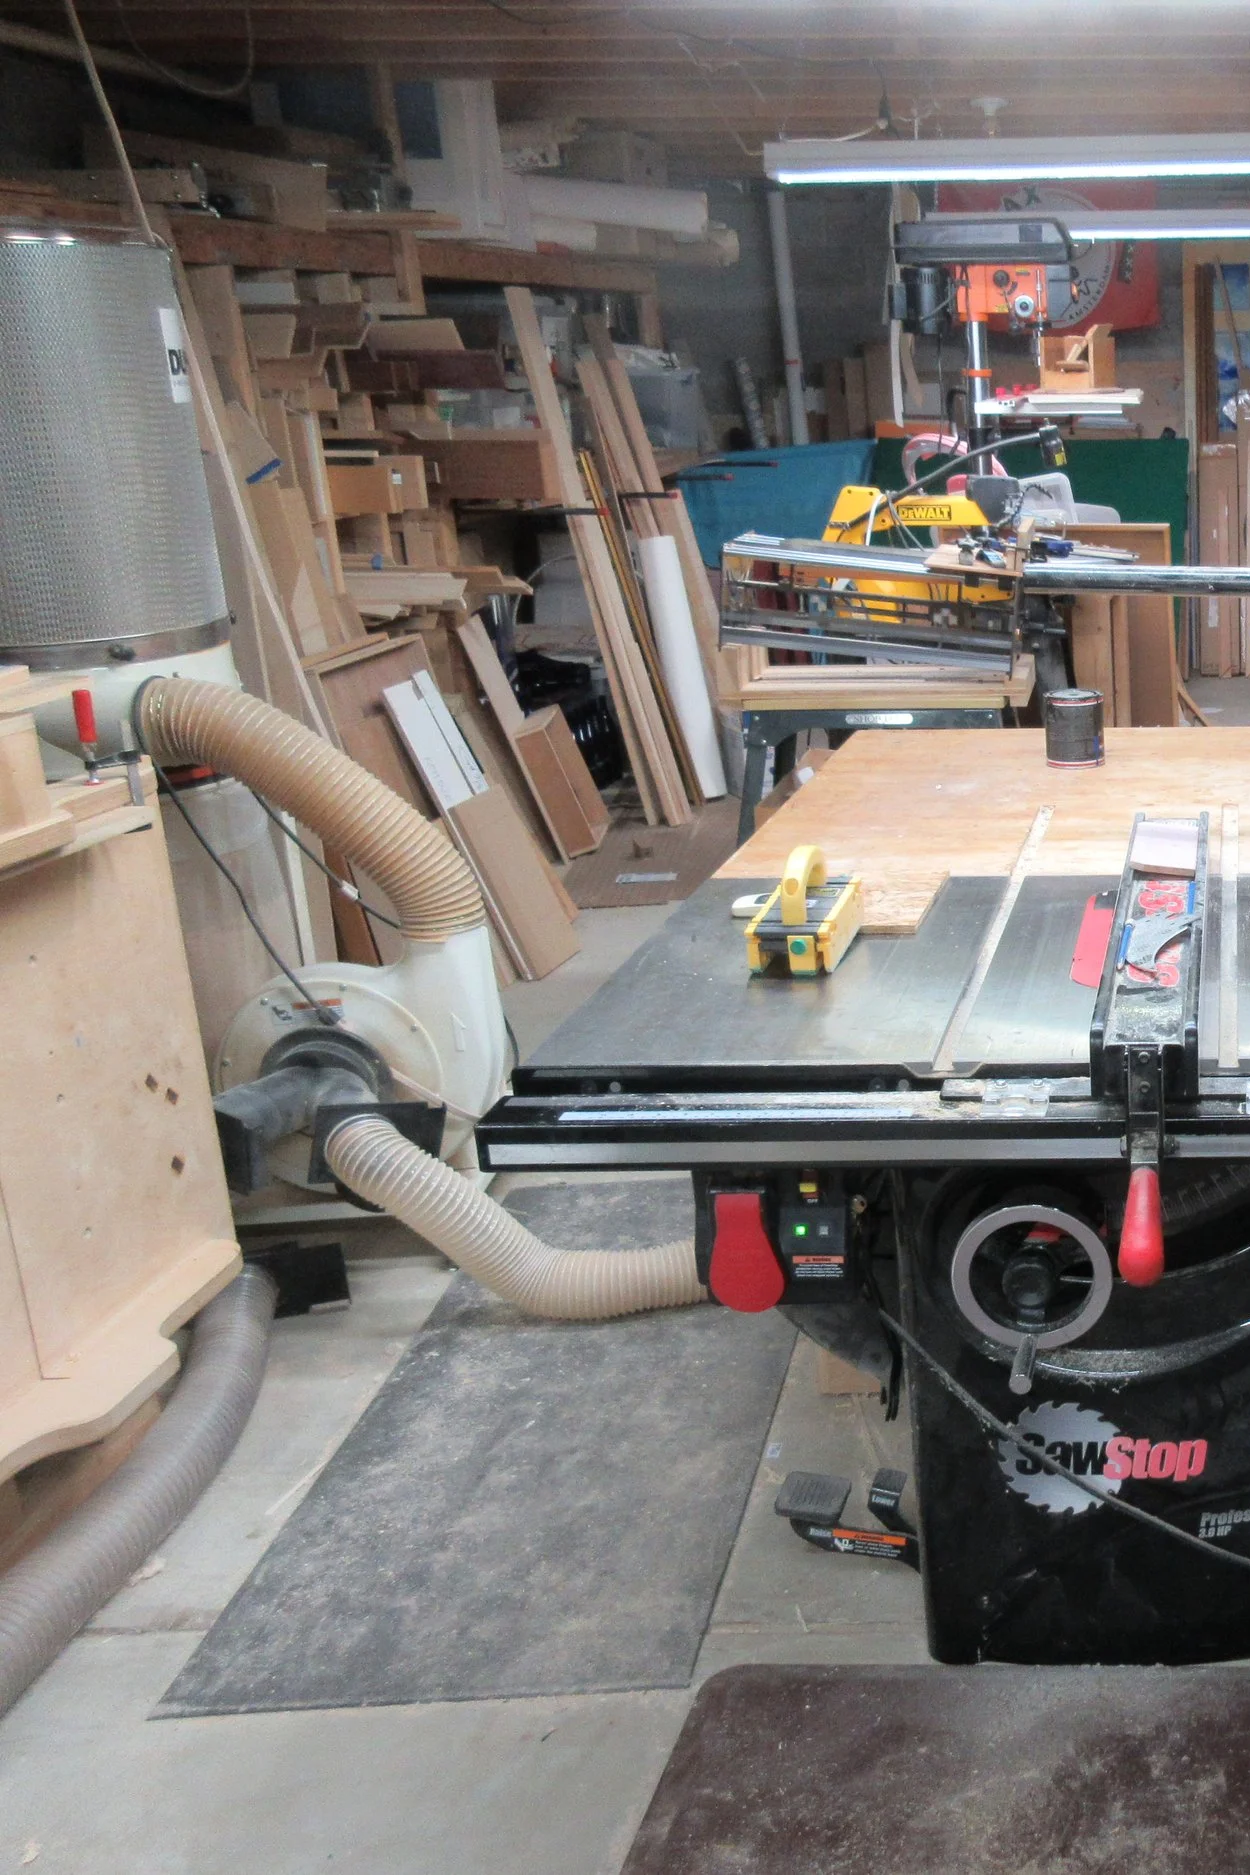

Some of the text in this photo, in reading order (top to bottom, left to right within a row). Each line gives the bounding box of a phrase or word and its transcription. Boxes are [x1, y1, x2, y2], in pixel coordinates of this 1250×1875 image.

[1015, 1433, 1208, 1483] SawStop
[871, 1494, 896, 1507] Lower
[1217, 1525, 1232, 1537] HP
